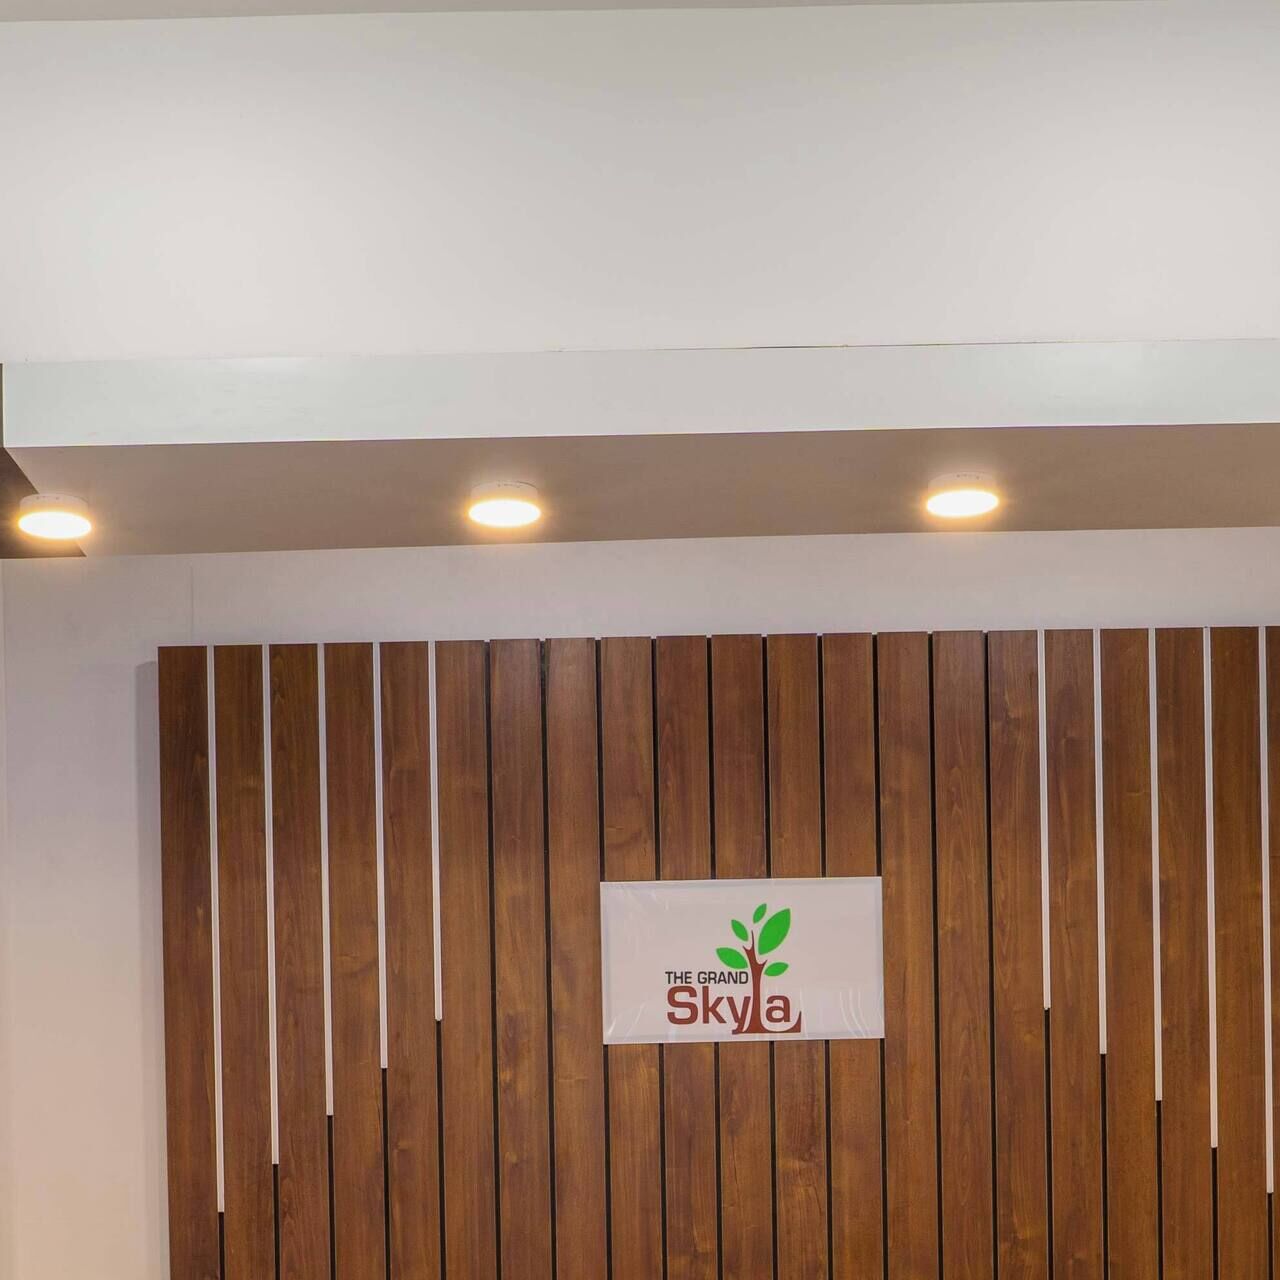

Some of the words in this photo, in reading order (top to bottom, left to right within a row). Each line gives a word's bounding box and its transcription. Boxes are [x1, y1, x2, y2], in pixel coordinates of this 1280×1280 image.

[665, 971, 693, 985] THE
[697, 970, 749, 985] GRAND
[666, 984, 802, 1035] Skyla
